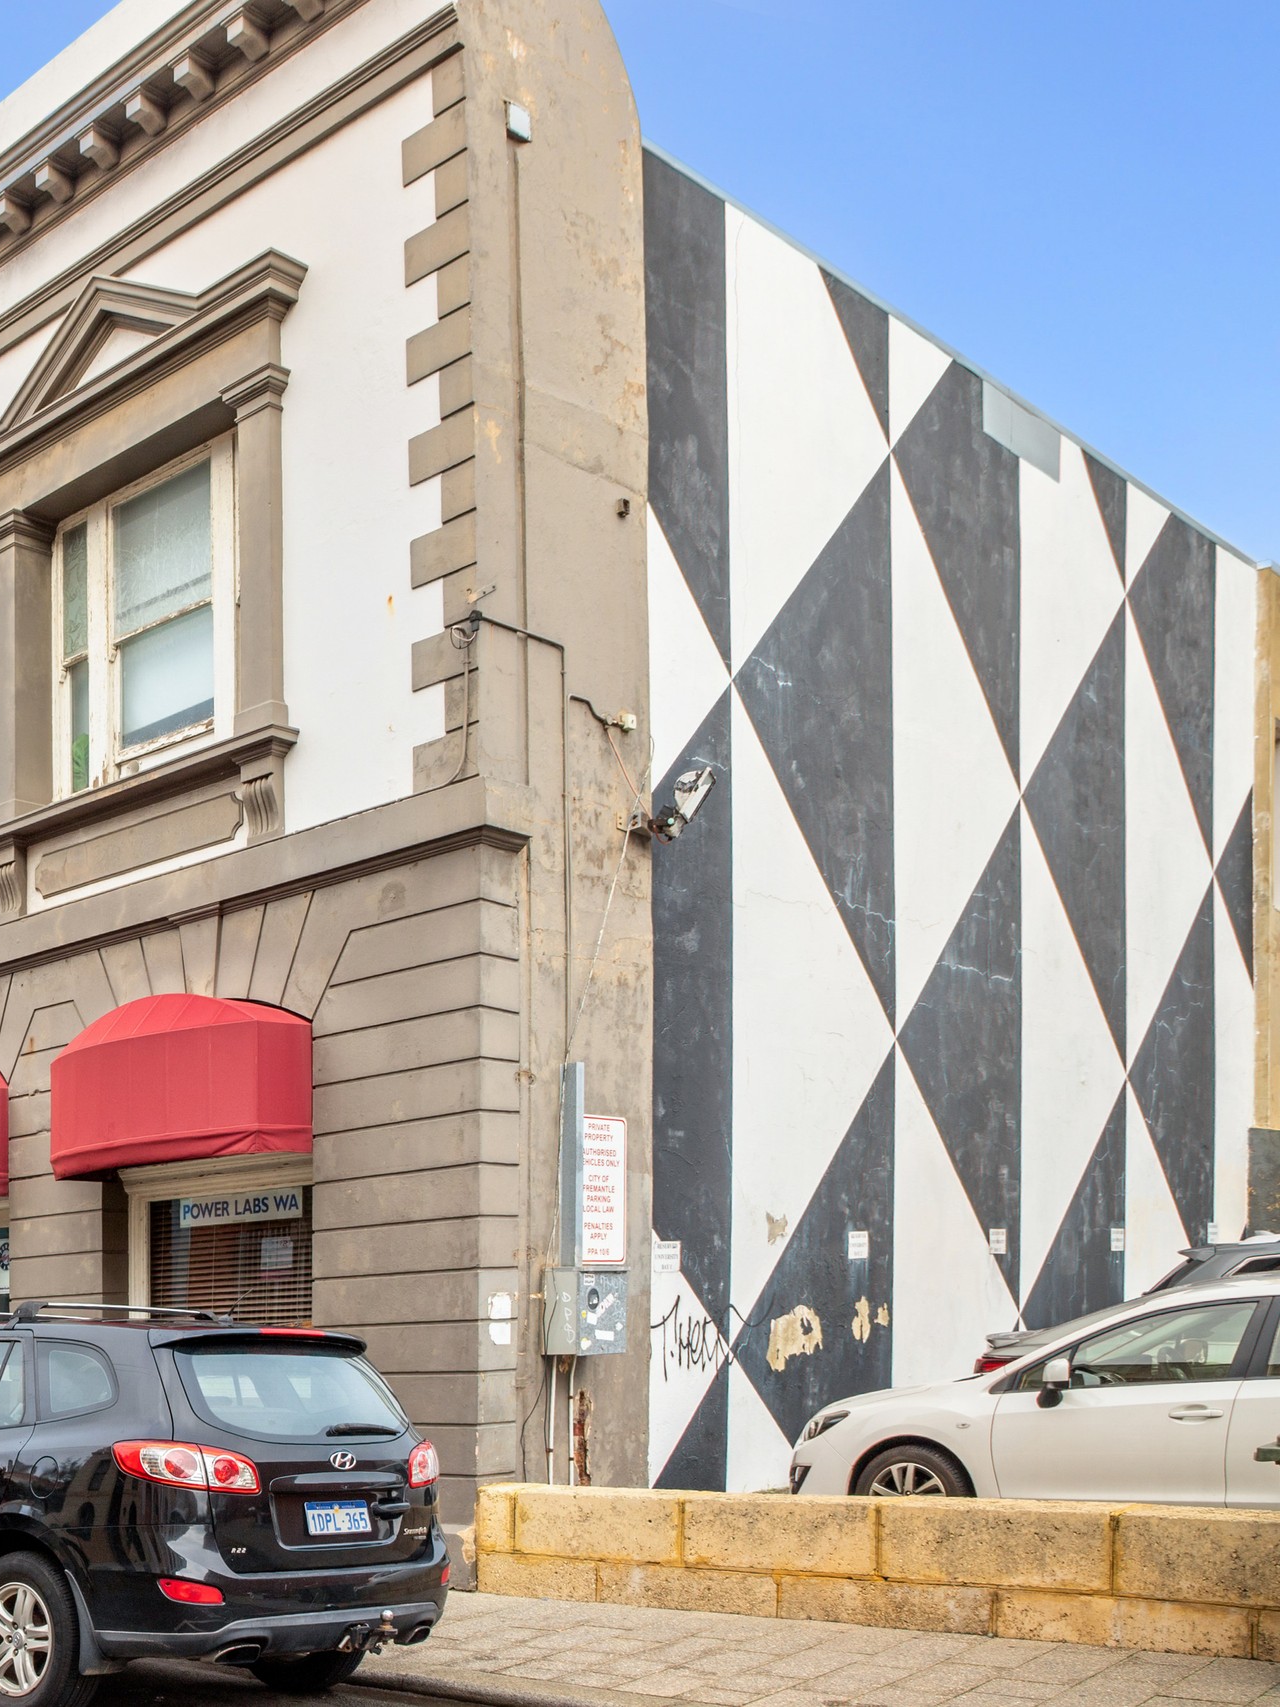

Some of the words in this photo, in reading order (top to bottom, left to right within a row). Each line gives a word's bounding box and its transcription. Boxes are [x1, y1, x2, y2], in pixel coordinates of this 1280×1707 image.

[588, 1122, 610, 1132] PRIVATE
[585, 1132, 613, 1142] PROPERTY
[583, 1158, 605, 1167] EHICLES
[606, 1159, 620, 1168] ONLY
[588, 1174, 601, 1182] CITY
[583, 1184, 615, 1194] FREMANTLE
[587, 1194, 611, 1203] PARKING
[183, 1201, 230, 1220] POWER
[234, 1196, 269, 1216] LABS
[273, 1193, 299, 1212] WA
[583, 1204, 601, 1213] LOCAL
[602, 1205, 614, 1214] LAW
[584, 1222, 613, 1231] PENALTIES
[590, 1232, 607, 1240] APPLY
